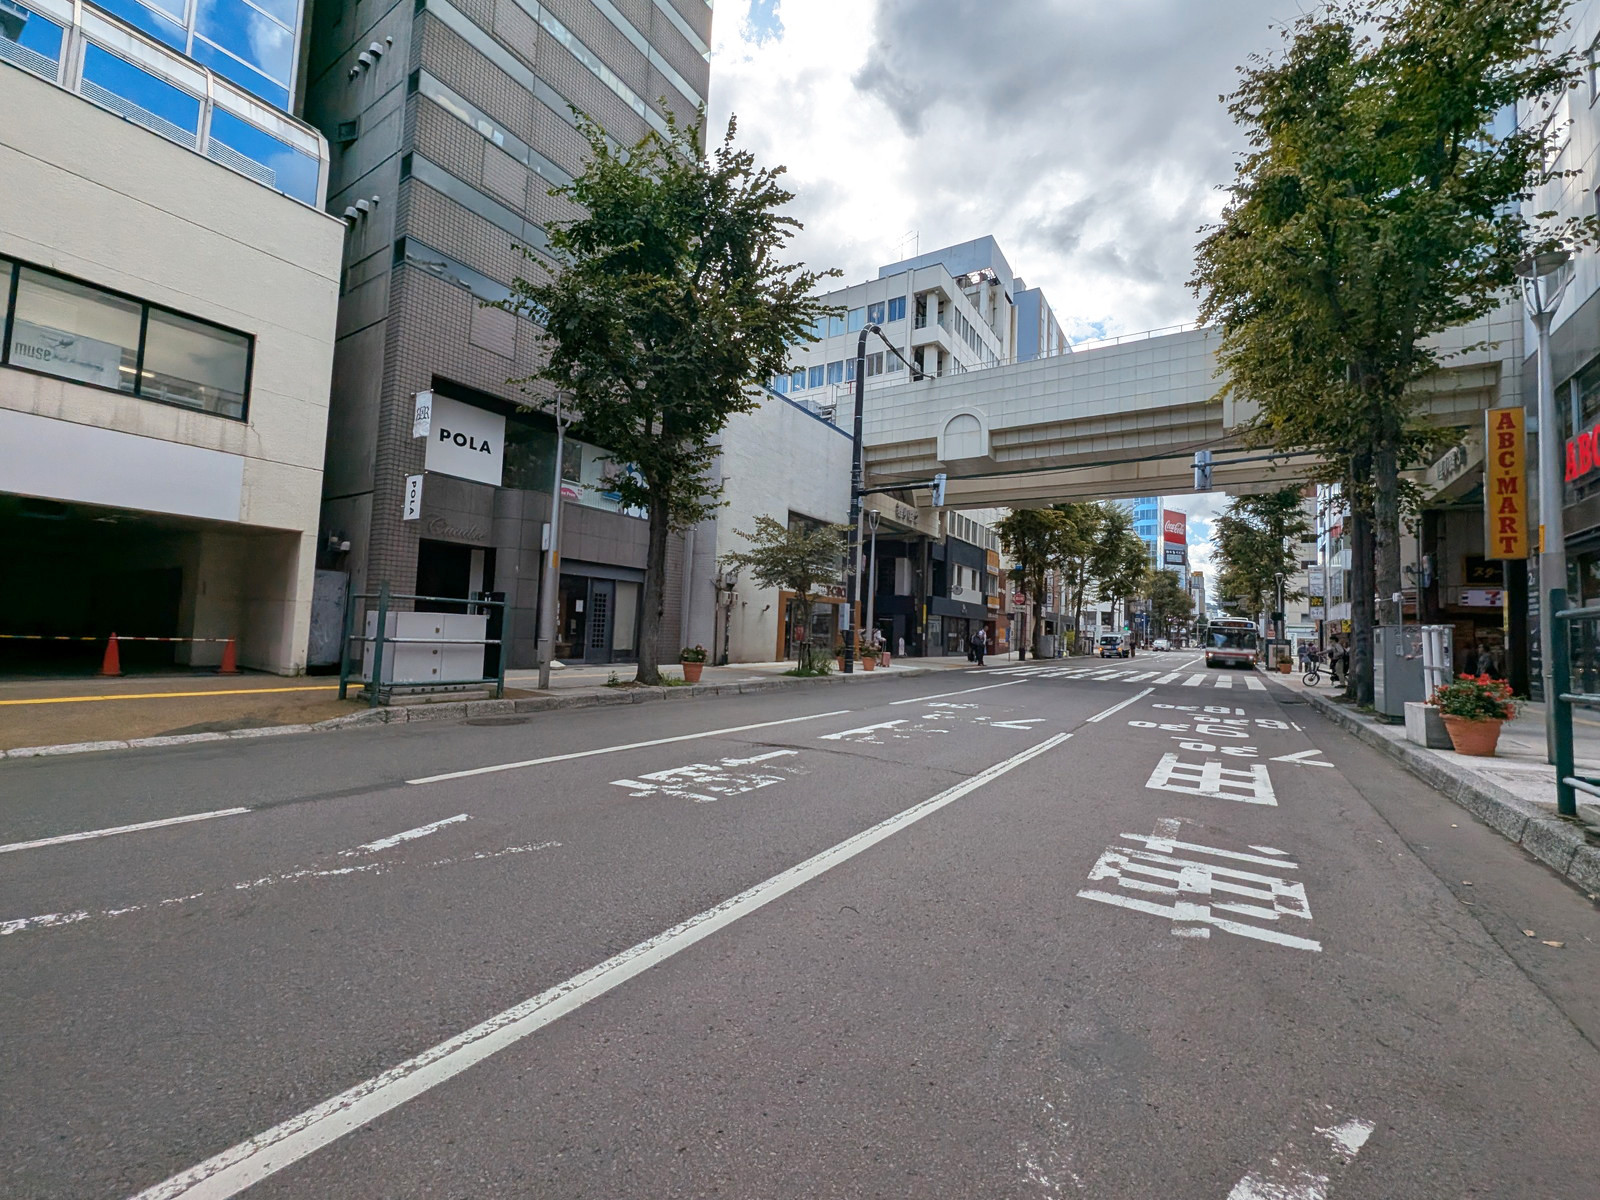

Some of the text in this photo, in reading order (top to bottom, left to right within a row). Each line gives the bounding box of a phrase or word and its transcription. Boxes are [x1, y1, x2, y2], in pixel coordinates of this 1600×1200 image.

[14, 342, 51, 362] muse
[438, 427, 492, 455] POLA
[408, 480, 417, 516] POLA
